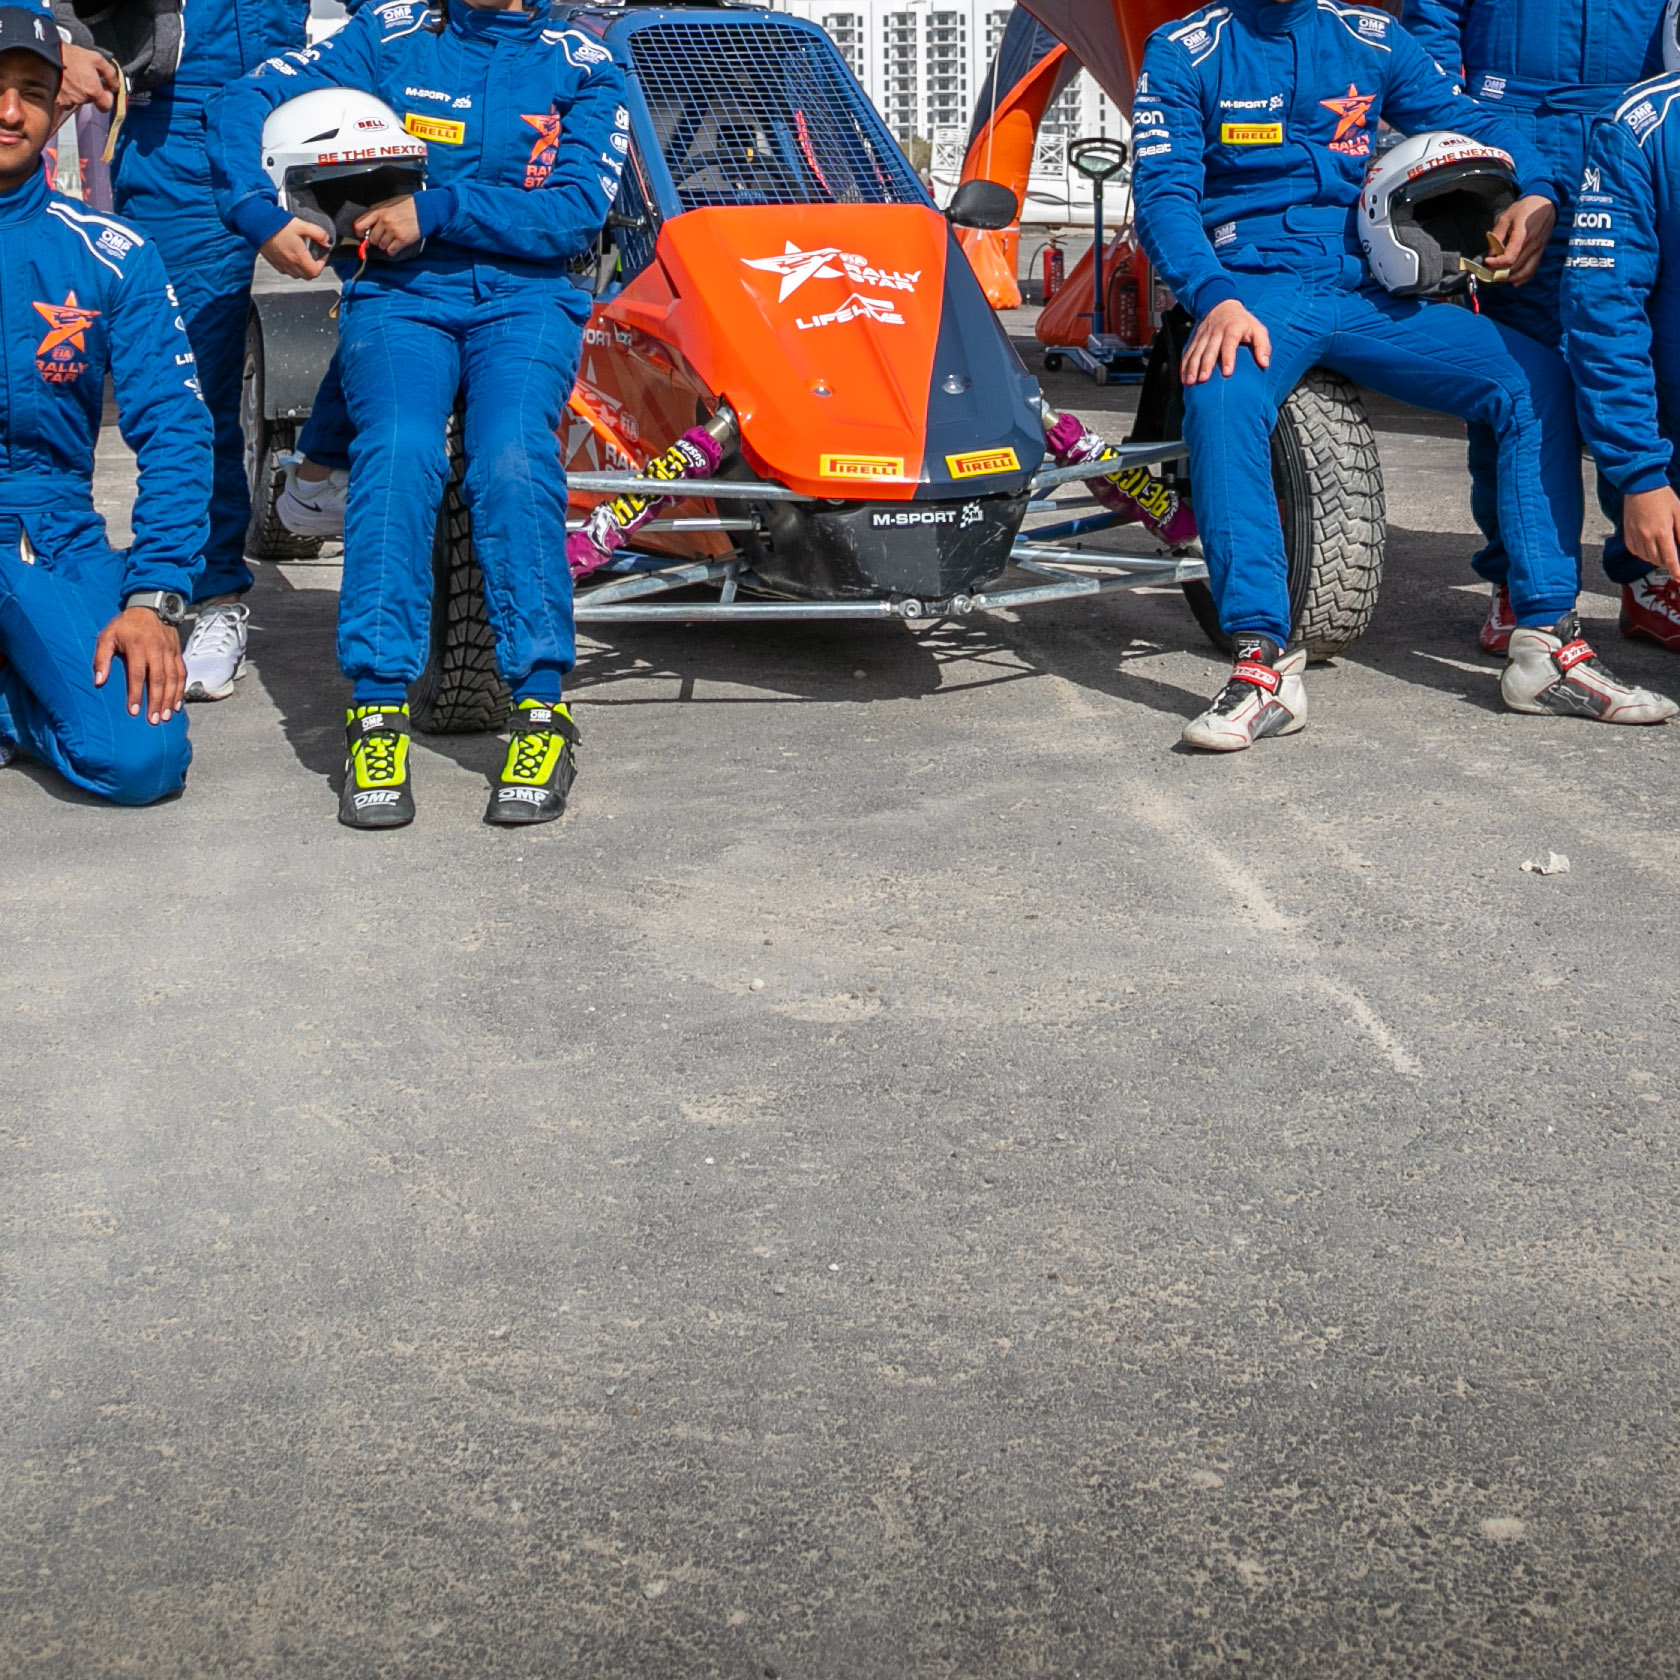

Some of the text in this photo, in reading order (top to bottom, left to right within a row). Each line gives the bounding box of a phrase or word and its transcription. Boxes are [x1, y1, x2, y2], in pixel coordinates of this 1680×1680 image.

[384, 7, 412, 19] OMP
[1358, 19, 1385, 31] OMP
[1184, 31, 1207, 47] OMP
[1484, 78, 1507, 90] OMP
[405, 87, 451, 102] M-SPORT
[1220, 99, 1268, 109] M-SPORT
[1627, 102, 1655, 126] OMP
[358, 120, 385, 128] BELL
[410, 118, 457, 139] PIRELLI
[1228, 127, 1277, 140] PIRELLI
[1329, 134, 1370, 151] RALLY
[318, 145, 417, 165] BE THE NEXT
[1407, 147, 1496, 180] BE THE NEXT
[101, 231, 131, 251] OMP
[844, 263, 922, 282] RALLY
[848, 272, 915, 292] STAR
[829, 459, 897, 475] PIRELLI
[955, 452, 1014, 472] PIRELLI
[872, 511, 957, 526] M-SPORT
[362, 716, 384, 728] OMP
[530, 710, 551, 720] OMP
[354, 793, 401, 807] OMP
[498, 788, 549, 802] OMP
